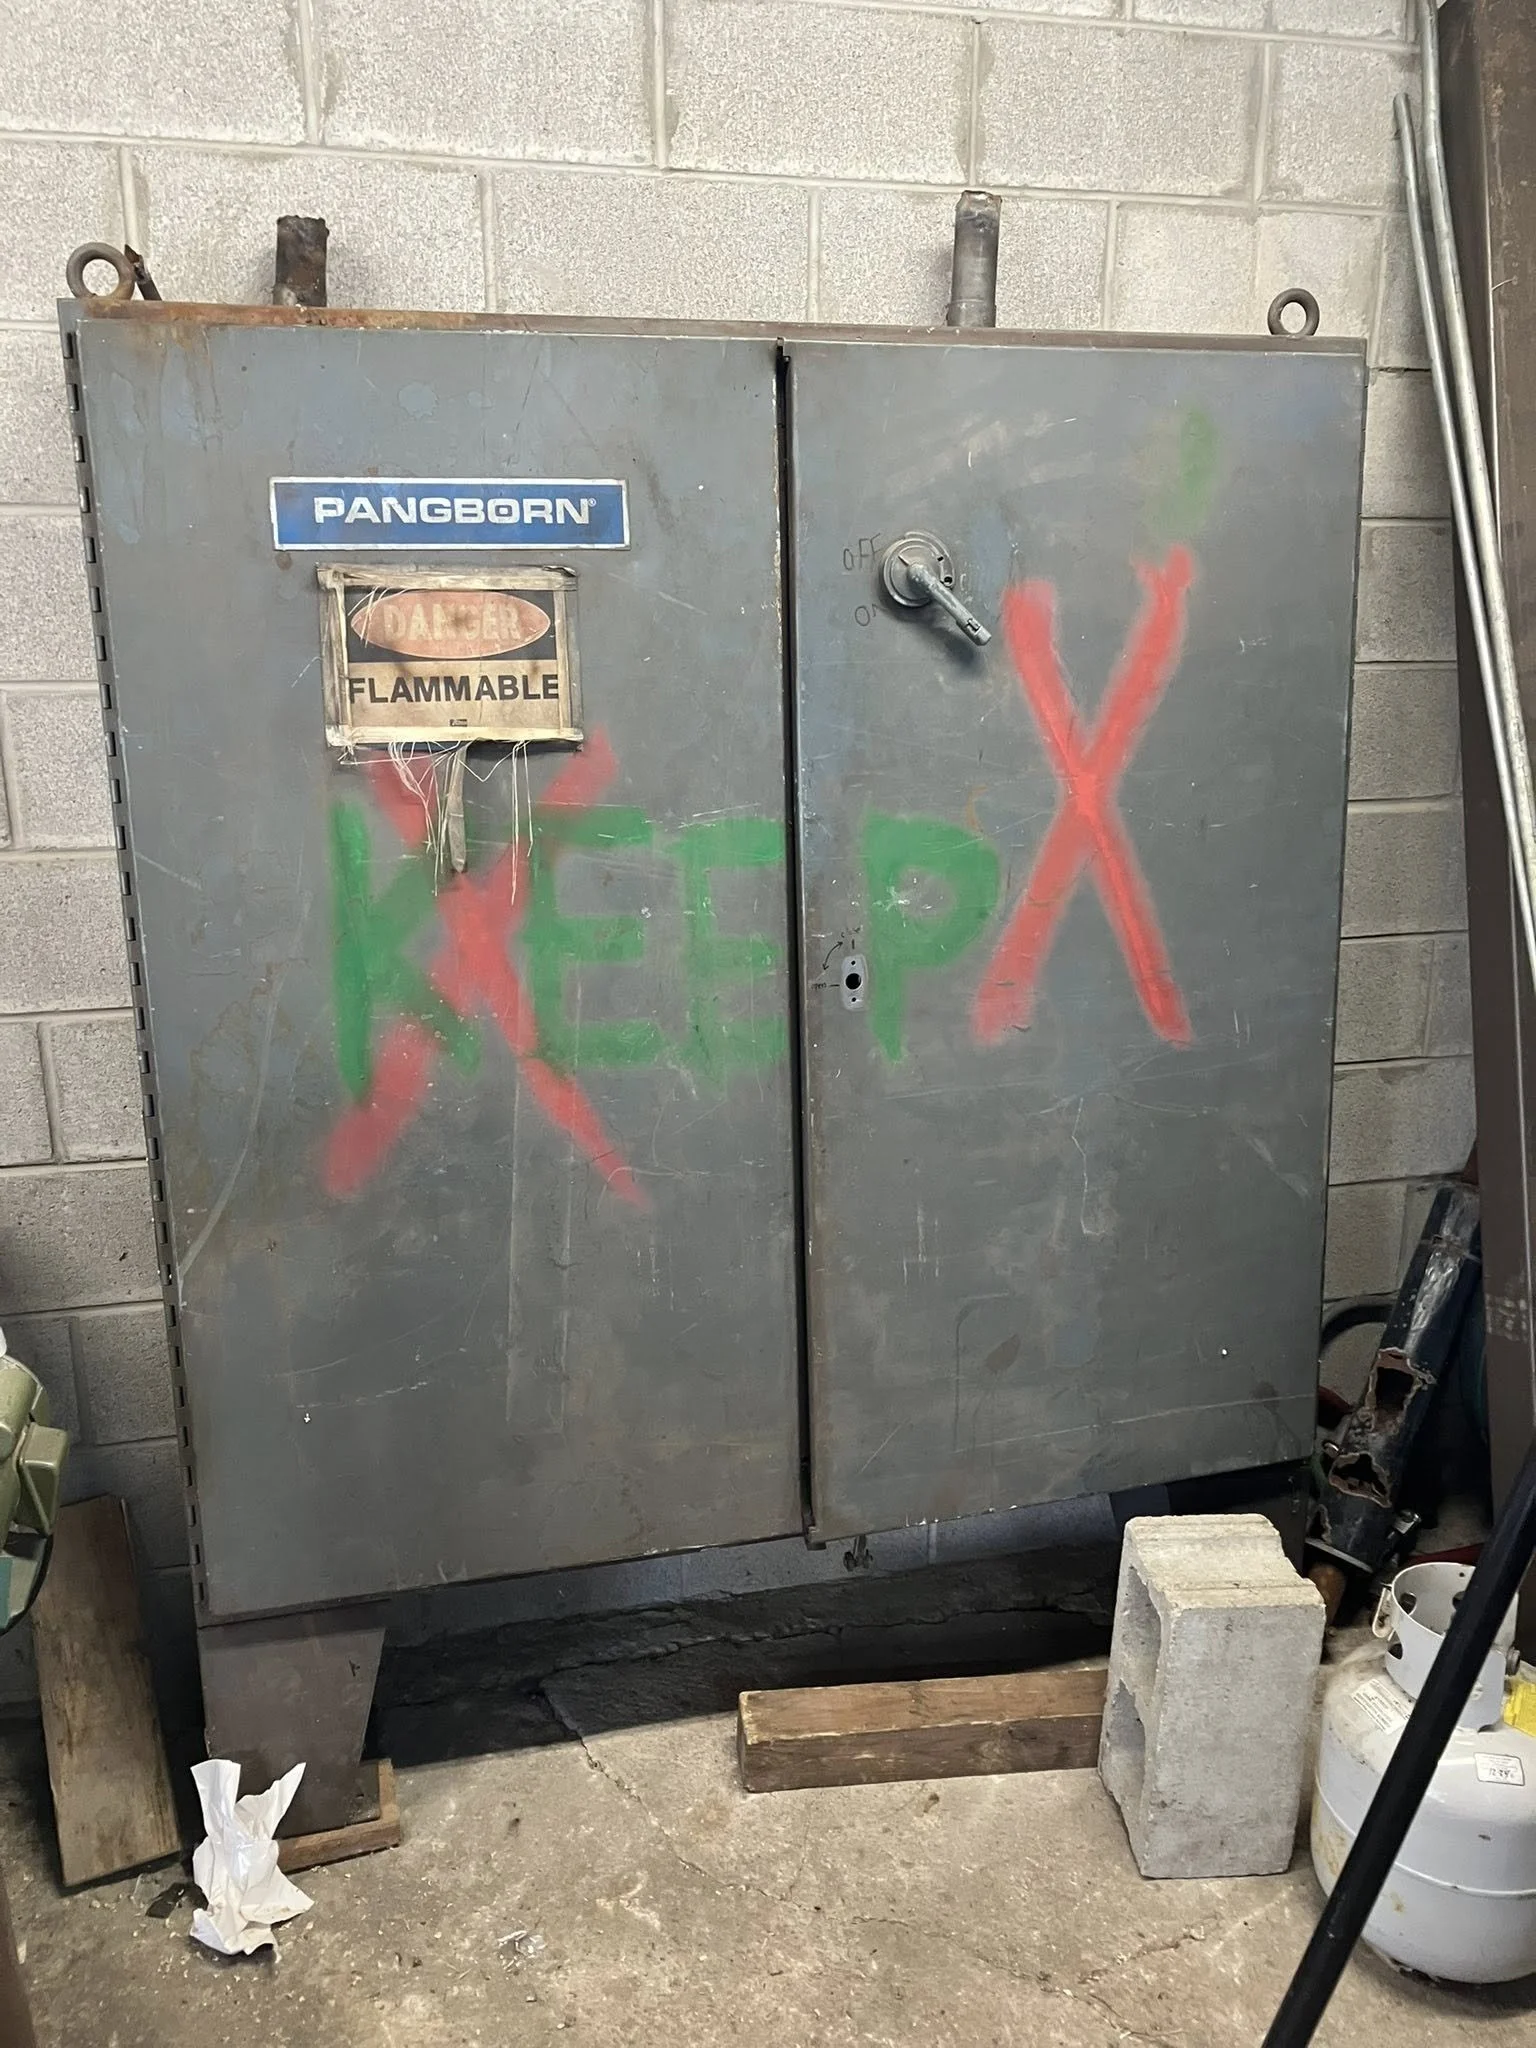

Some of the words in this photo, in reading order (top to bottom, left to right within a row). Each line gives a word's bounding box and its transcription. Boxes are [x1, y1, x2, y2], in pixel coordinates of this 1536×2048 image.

[843, 532, 882, 571] OFF
[382, 601, 521, 643] DANGER
[349, 673, 559, 704] FLAMMABLE
[330, 797, 999, 1100] KEEP
